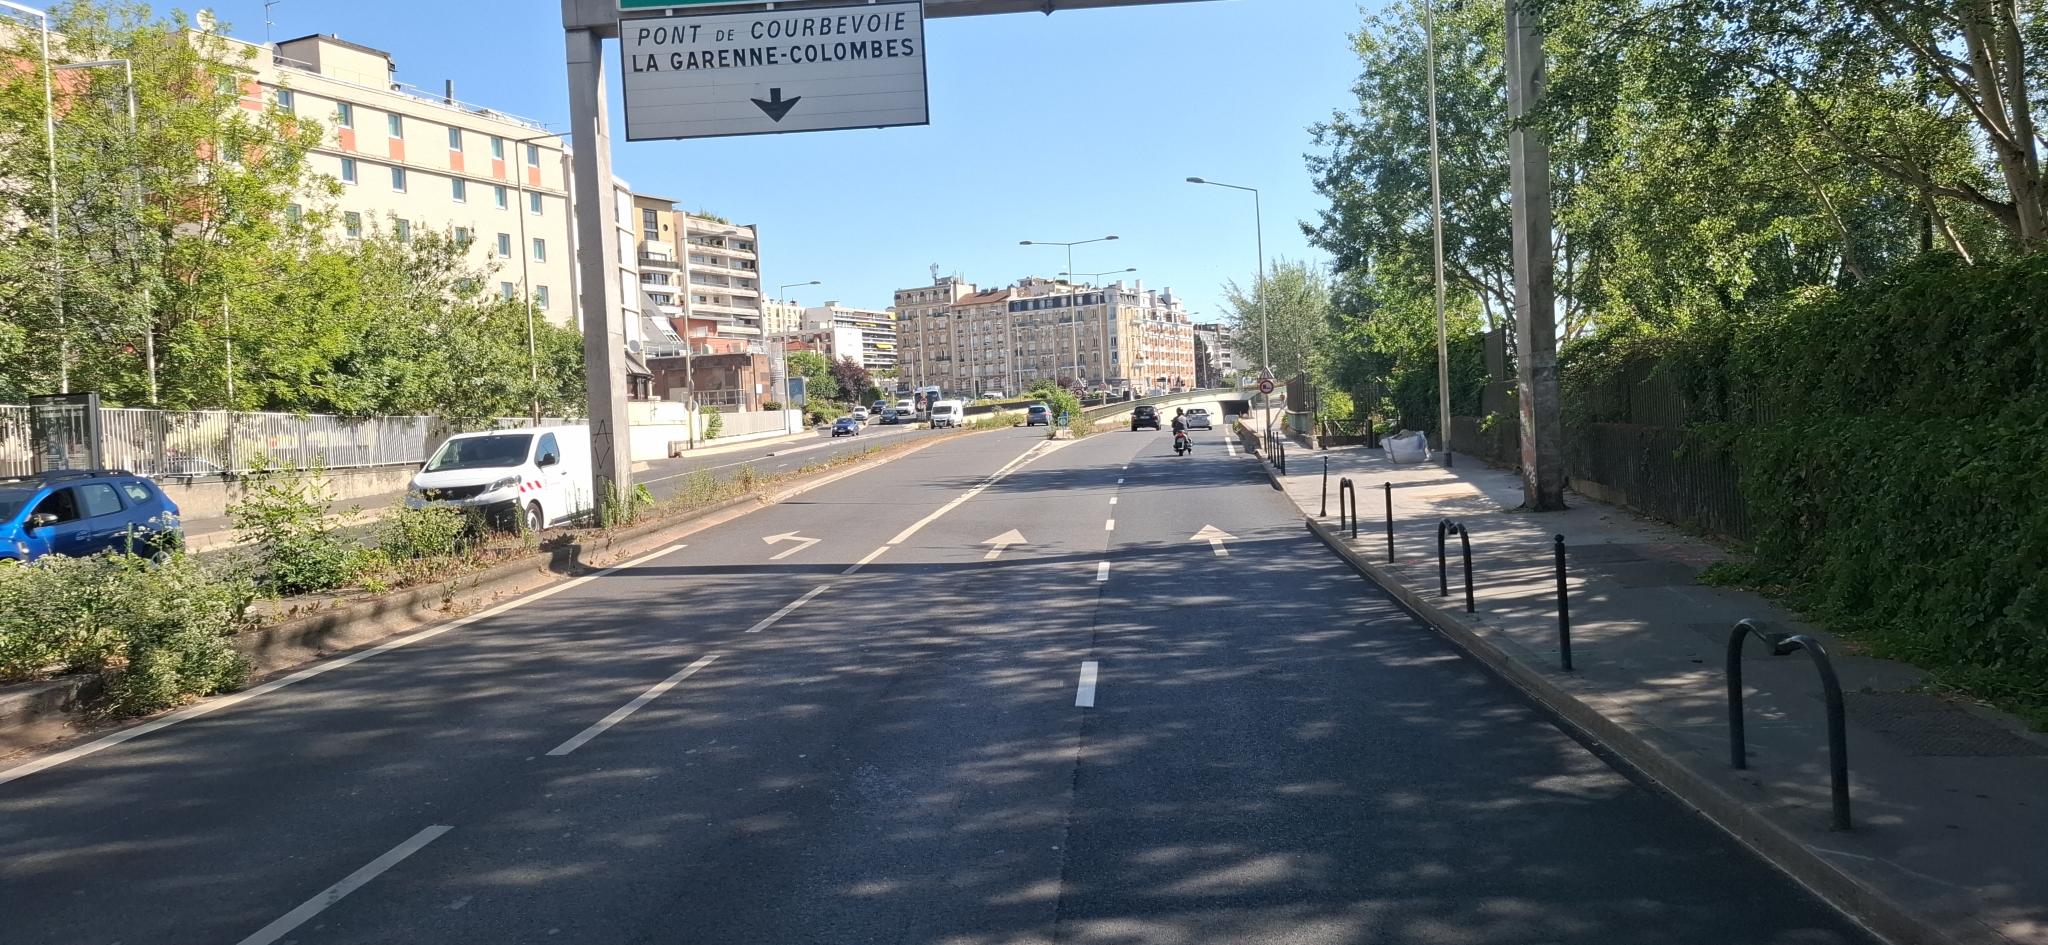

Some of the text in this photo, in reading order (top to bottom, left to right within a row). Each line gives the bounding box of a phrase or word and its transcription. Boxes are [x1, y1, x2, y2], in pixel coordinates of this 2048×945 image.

[637, 12, 906, 46] PONT DE COURBEVOIE
[632, 38, 914, 72] LA GARENNE-COLOMBES
